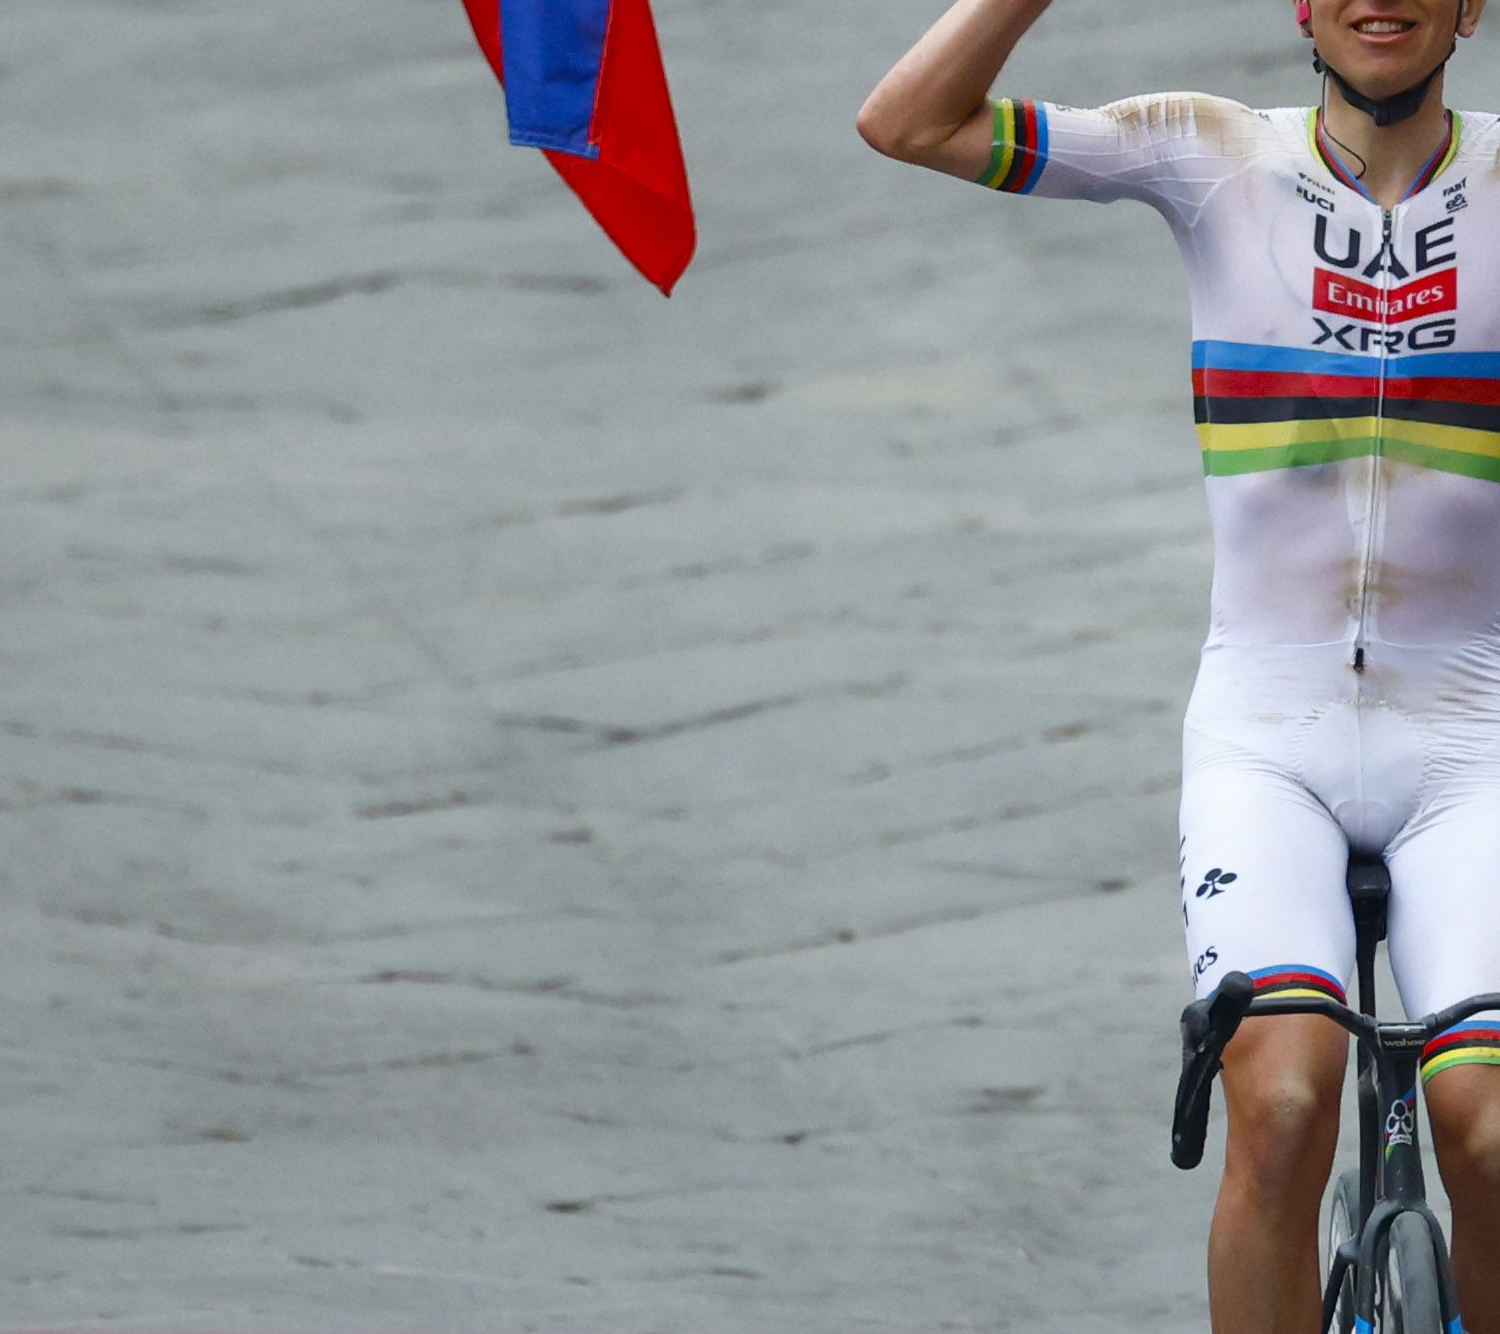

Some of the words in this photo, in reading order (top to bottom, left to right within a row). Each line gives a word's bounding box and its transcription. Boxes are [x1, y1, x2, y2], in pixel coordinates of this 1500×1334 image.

[1303, 188, 1335, 213] UCI
[1313, 212, 1457, 281] UAE
[1311, 317, 1456, 354] XRG
